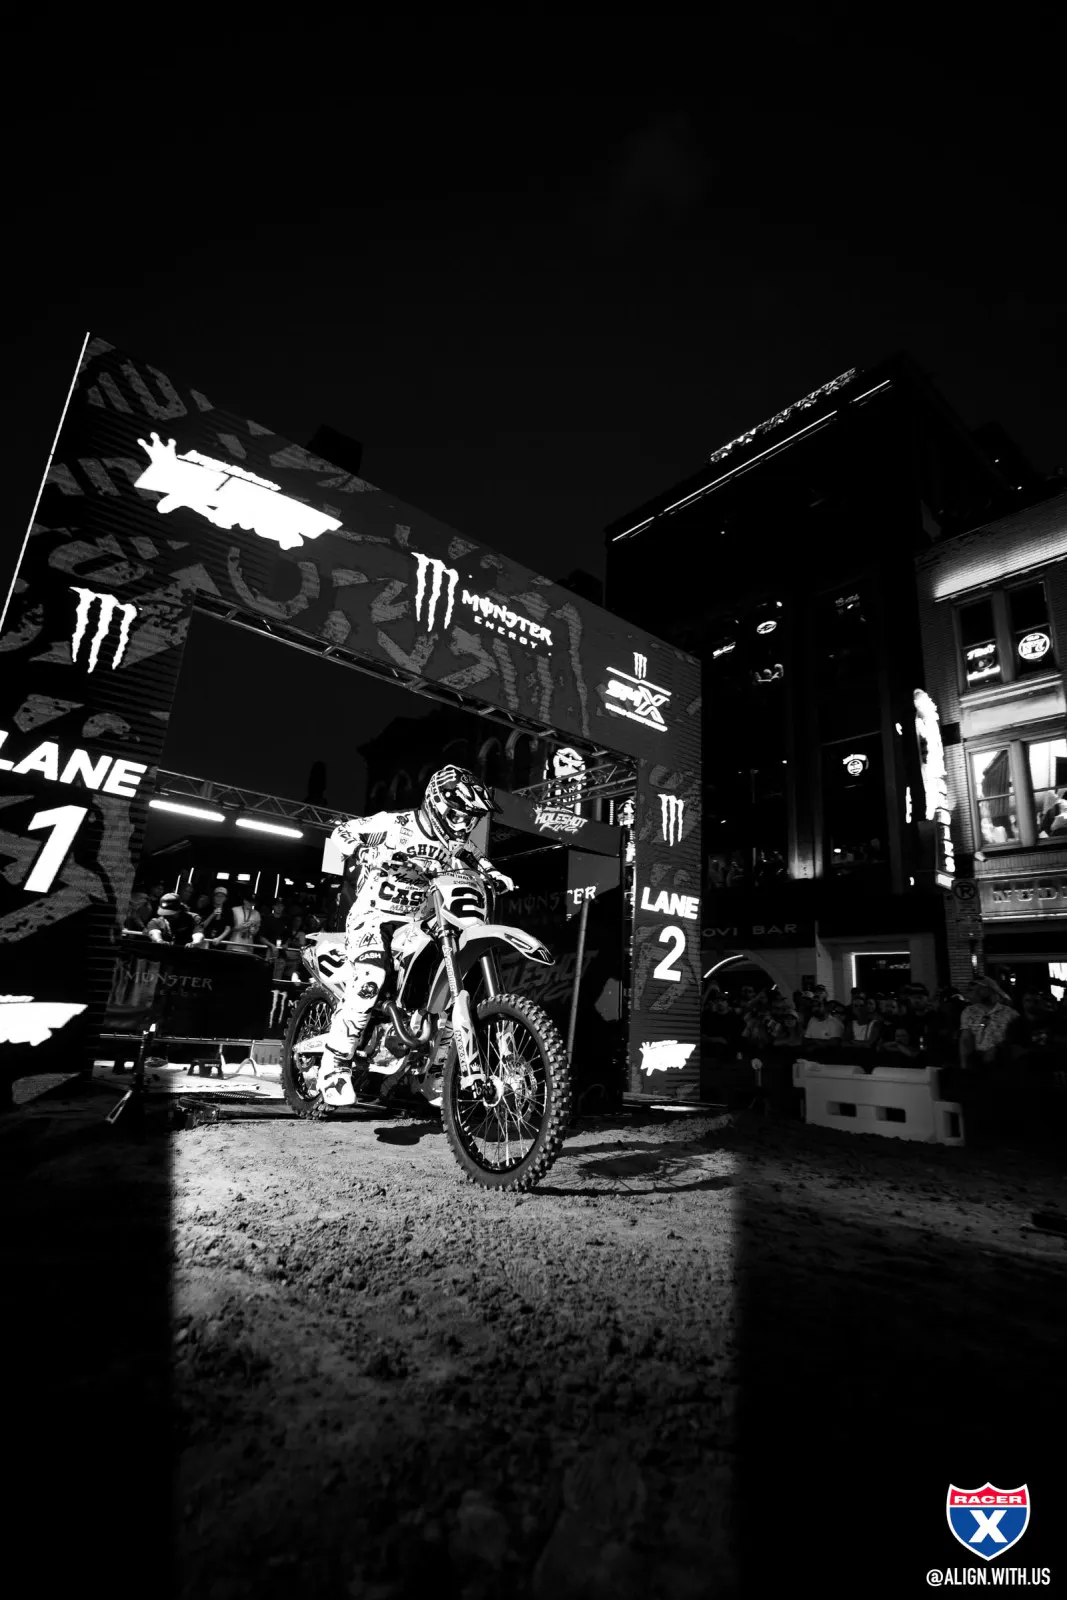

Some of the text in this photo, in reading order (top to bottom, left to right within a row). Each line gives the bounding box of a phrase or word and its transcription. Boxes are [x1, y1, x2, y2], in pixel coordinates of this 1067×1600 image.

[462, 589, 553, 646] MONSTER
[474, 615, 538, 649] ENERGY
[534, 812, 588, 828] HOLESHOT
[23, 804, 89, 893] 1
[450, 887, 486, 918] 2
[640, 886, 700, 920] LANE
[751, 923, 798, 935] BAR
[358, 952, 382, 961] CASH
[652, 925, 687, 982] 2
[124, 971, 214, 993] MONSTER
